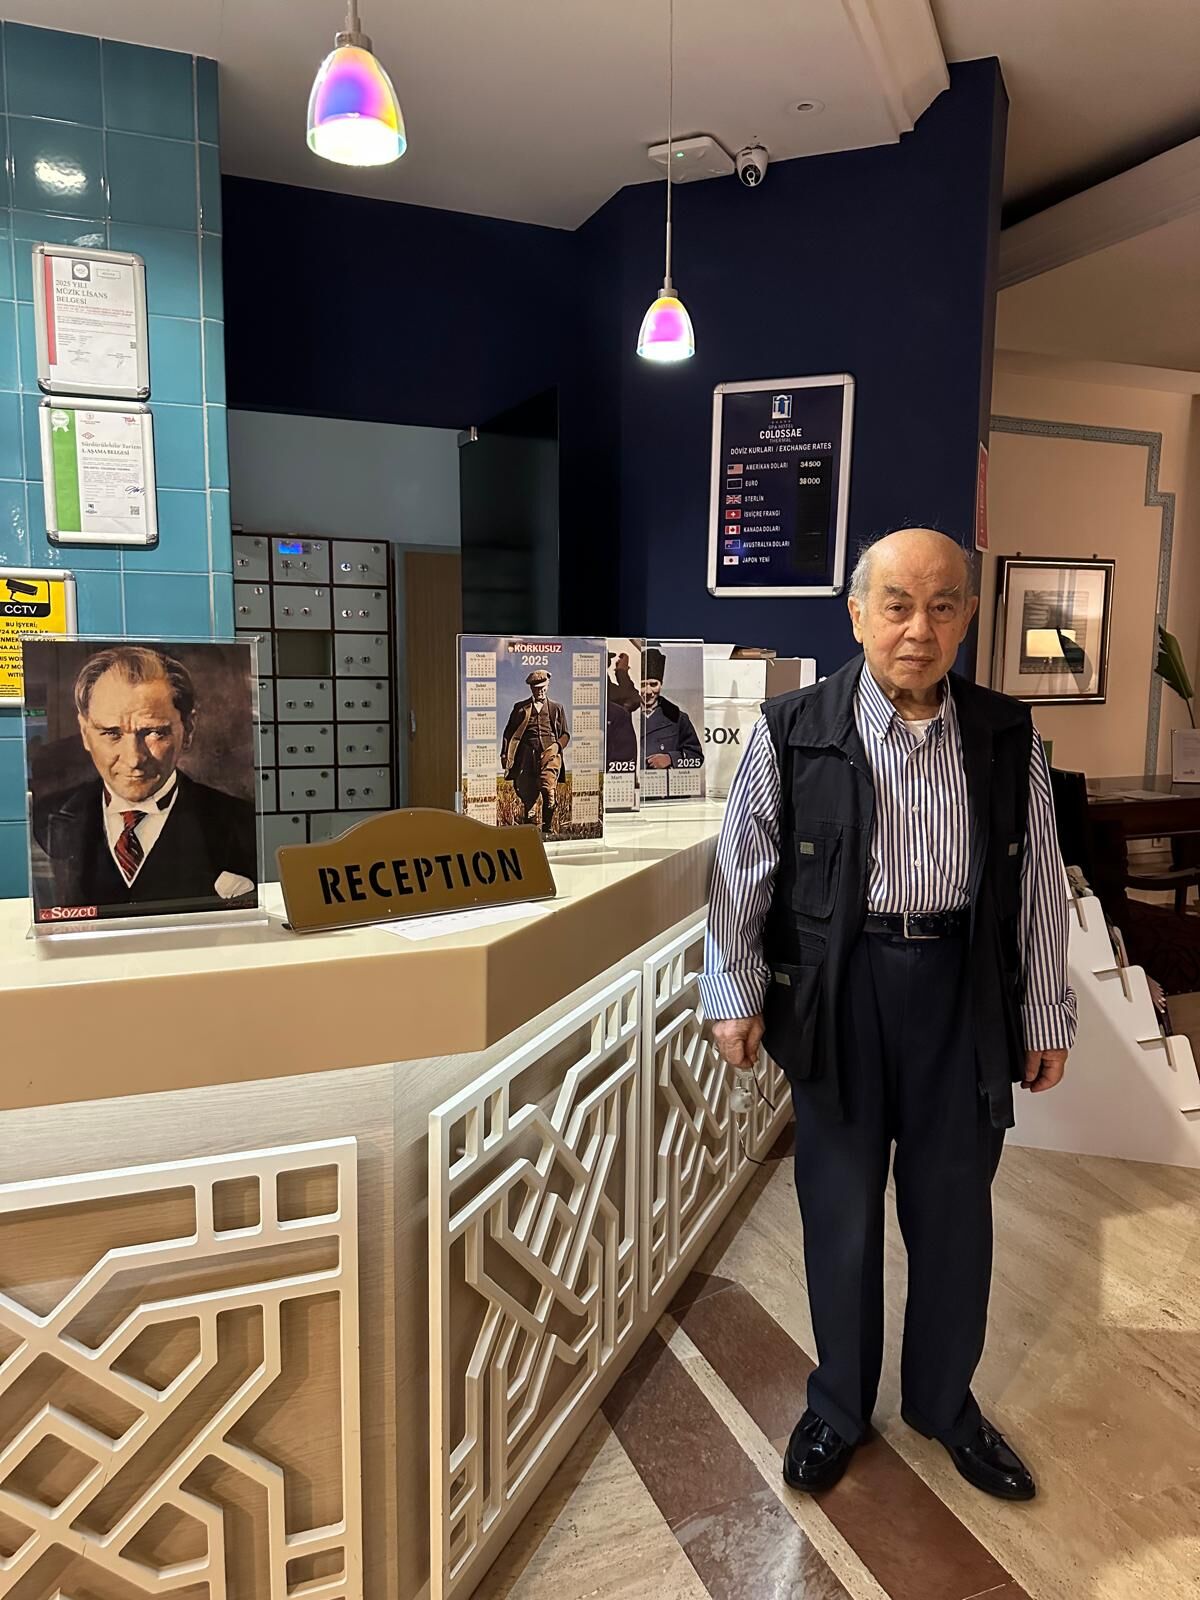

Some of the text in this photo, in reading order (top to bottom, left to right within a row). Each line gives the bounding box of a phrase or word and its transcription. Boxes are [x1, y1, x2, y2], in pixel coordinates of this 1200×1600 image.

[759, 428, 803, 440] COLOSSAE
[748, 446, 774, 454] KURLARI
[779, 443, 812, 452] EXCHANGE
[812, 442, 832, 450] RATES
[4, 604, 38, 614] CCTV
[514, 644, 562, 653] KORKUSUZ
[521, 655, 549, 666] 2025
[704, 727, 741, 745] BOX
[608, 761, 636, 772] 2025
[678, 758, 702, 768] 2025
[318, 848, 523, 904] RECEPTION
